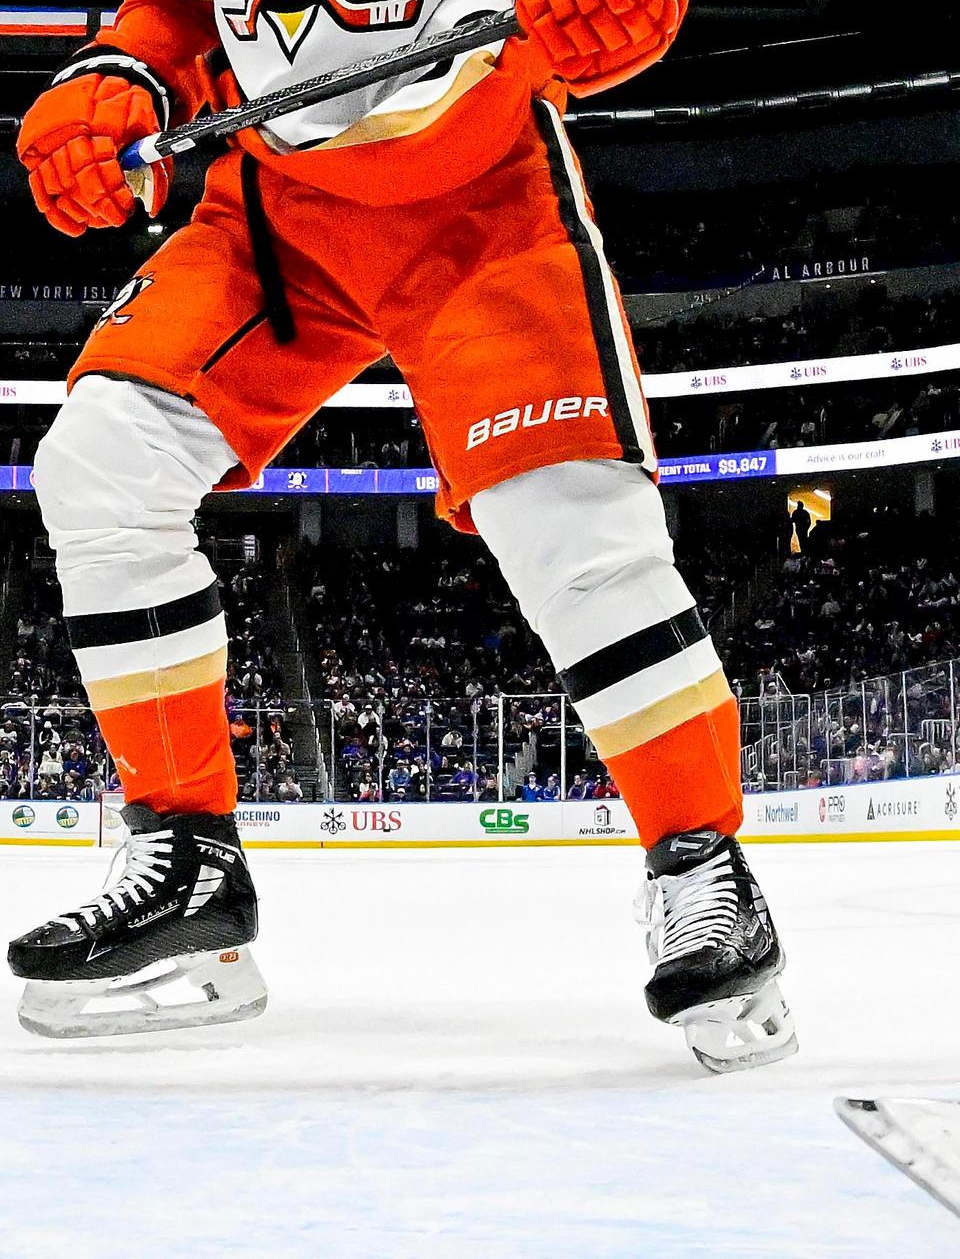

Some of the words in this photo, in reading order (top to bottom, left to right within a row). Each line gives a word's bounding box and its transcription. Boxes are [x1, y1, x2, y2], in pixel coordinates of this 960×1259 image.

[772, 266, 791, 282] AL
[802, 256, 871, 280] ARBOUR
[32, 286, 74, 300] YORK
[905, 355, 928, 370] UBS
[704, 375, 727, 388] UBS
[804, 365, 827, 380] UBS
[682, 462, 711, 476] TOTAL
[718, 456, 767, 477] $9,847
[806, 453, 835, 465] Advice
[764, 802, 798, 823] Northwell
[876, 799, 919, 817] ACRISURE
[351, 810, 402, 833] UBS
[196, 843, 236, 866] TRUE
